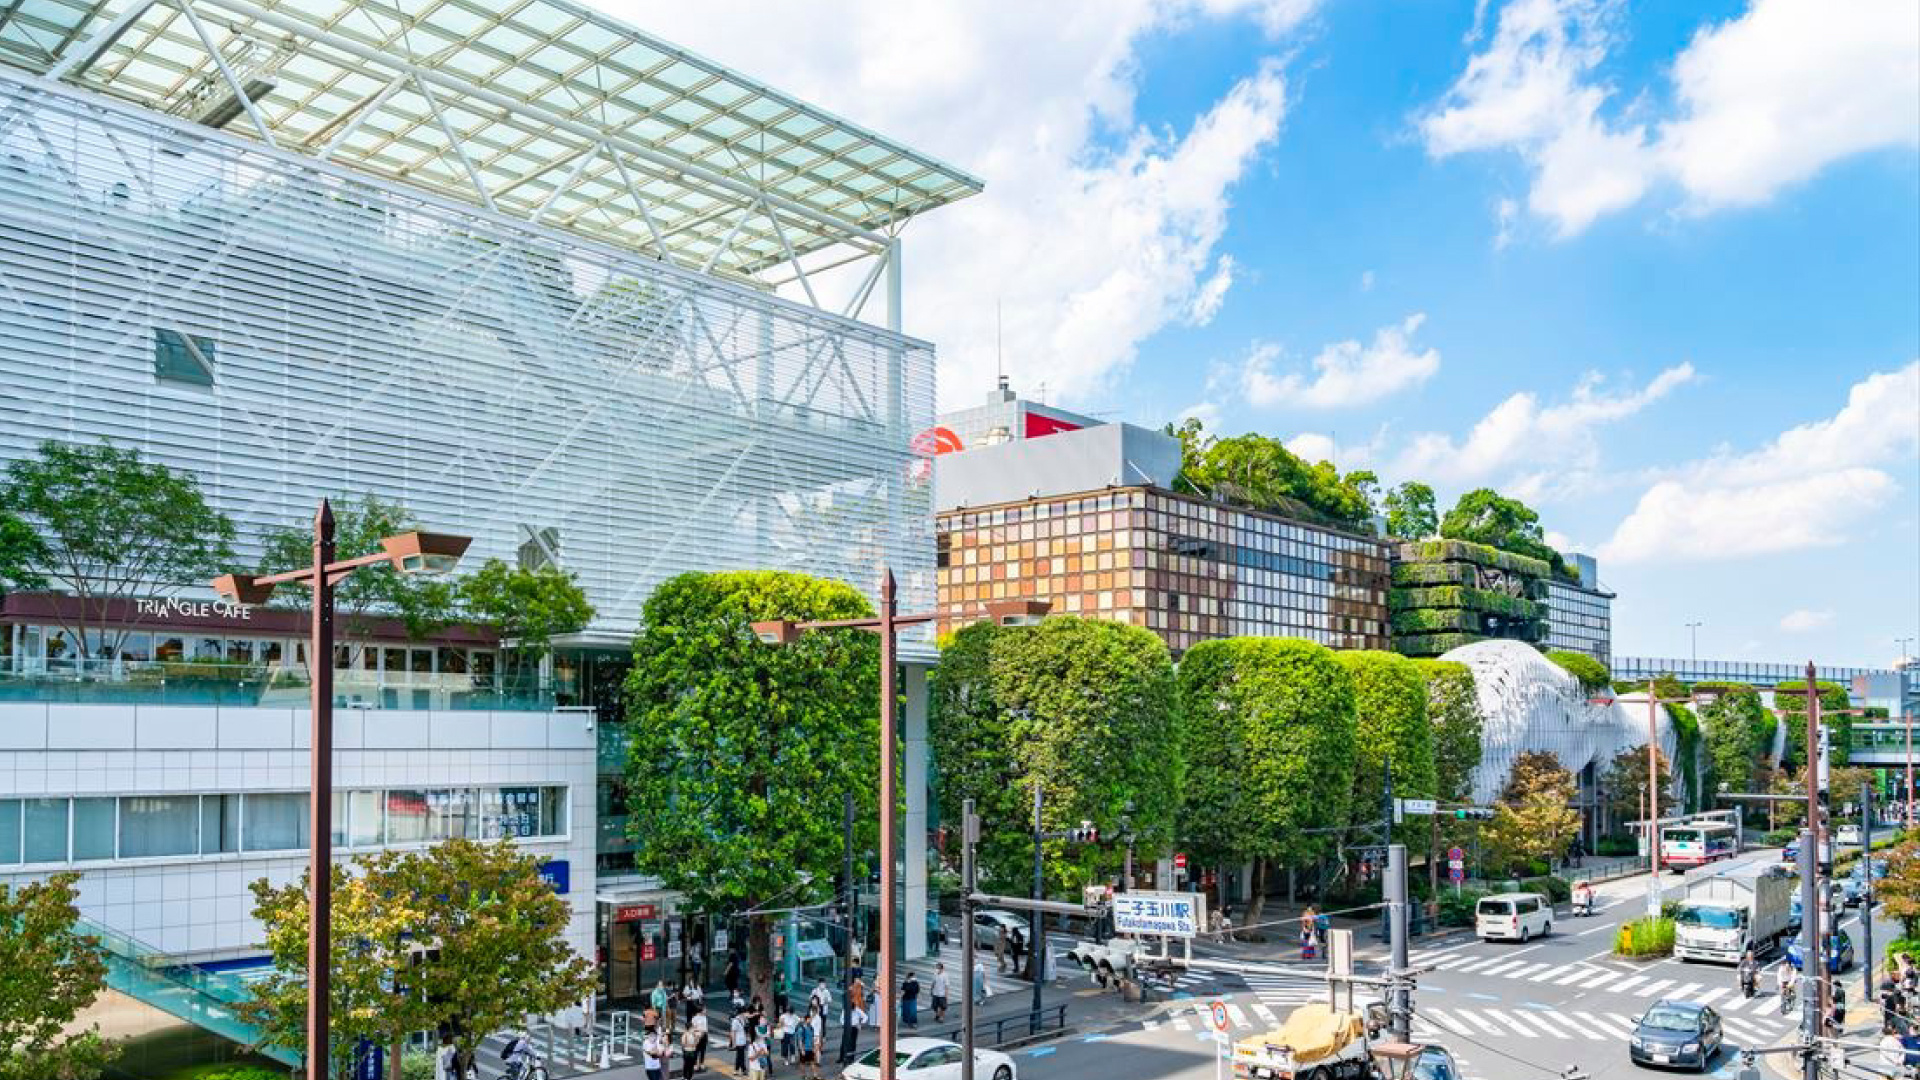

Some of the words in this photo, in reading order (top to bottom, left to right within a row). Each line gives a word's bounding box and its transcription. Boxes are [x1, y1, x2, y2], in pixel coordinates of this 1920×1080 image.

[136, 597, 208, 617] TRIANGLE
[213, 600, 250, 619] CAFE
[1116, 900, 1190, 918] 二子玉川駅
